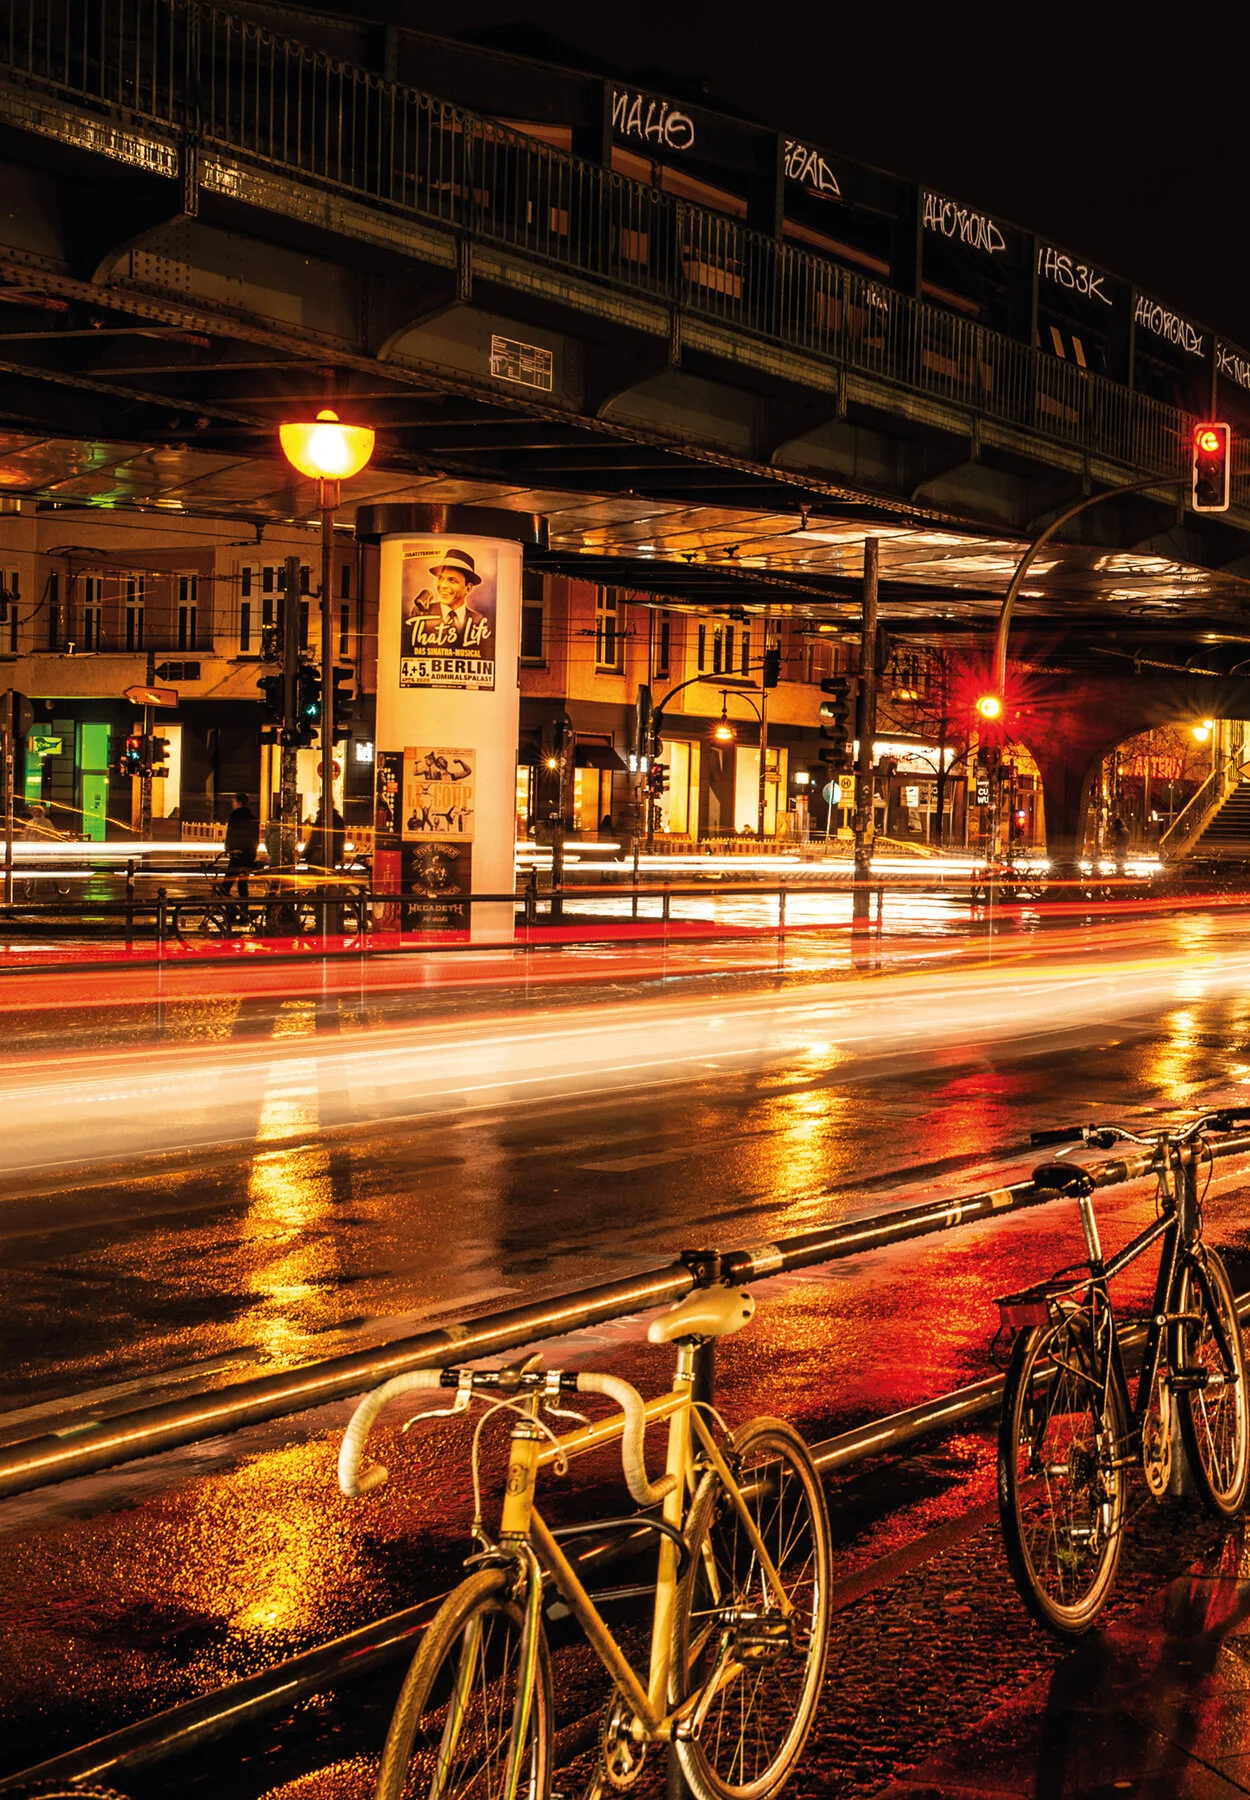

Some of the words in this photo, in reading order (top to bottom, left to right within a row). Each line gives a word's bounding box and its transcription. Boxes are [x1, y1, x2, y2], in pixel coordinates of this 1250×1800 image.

[405, 615, 457, 646] That's
[462, 617, 492, 647] Life
[414, 647, 427, 656] DAS
[427, 648, 482, 658] SINATRA-MUSICAL
[431, 659, 493, 675] BERLIN
[430, 673, 493, 682] ADMIRALSPALAST
[434, 784, 472, 809] COUP
[407, 903, 465, 916] MEGADETH
